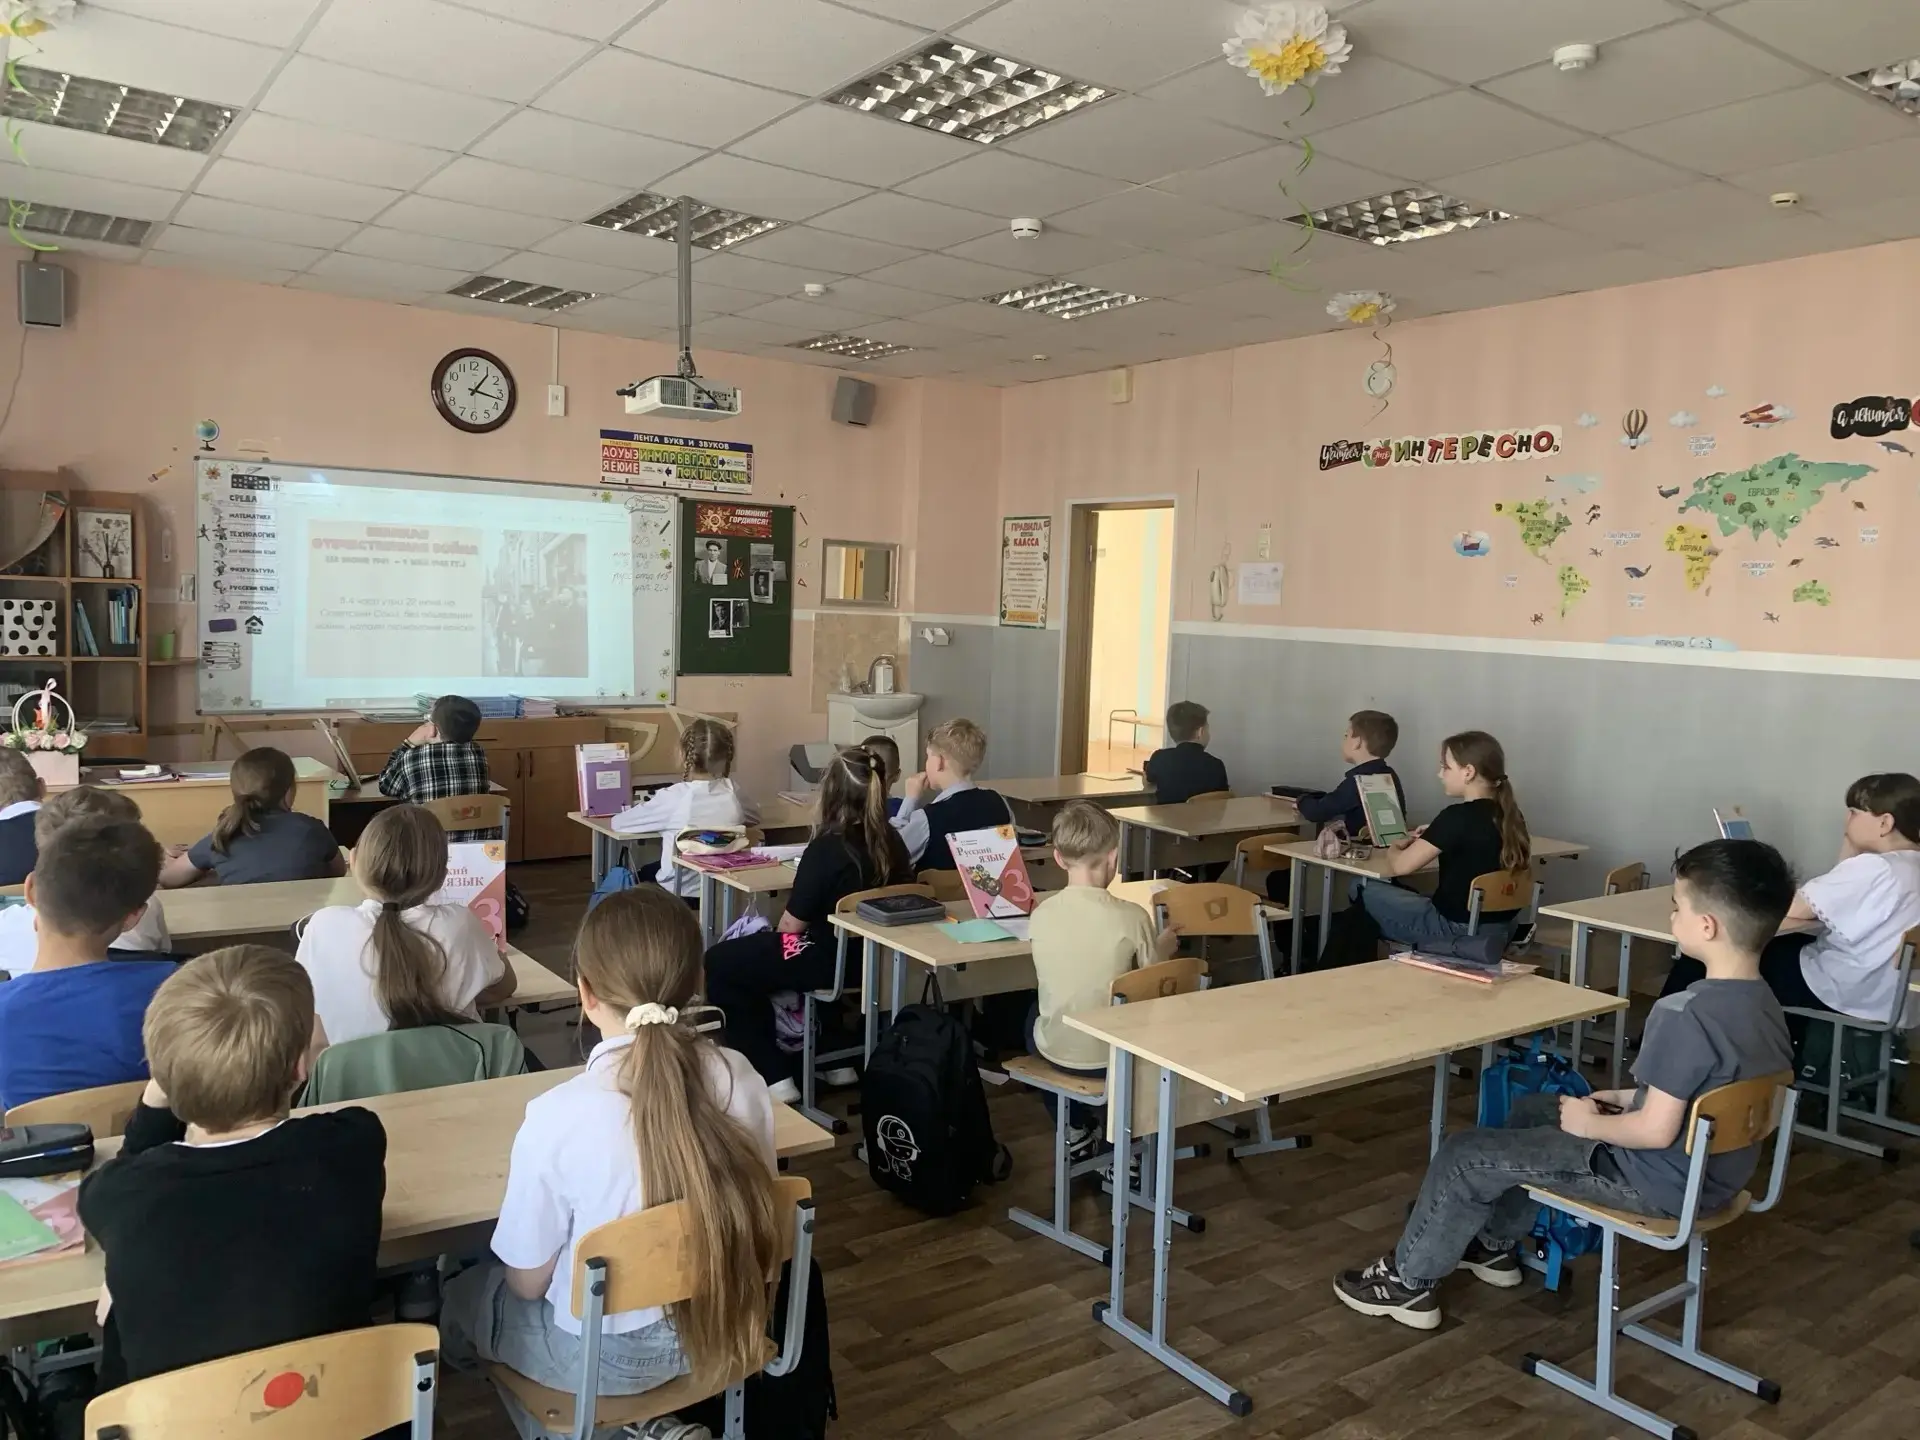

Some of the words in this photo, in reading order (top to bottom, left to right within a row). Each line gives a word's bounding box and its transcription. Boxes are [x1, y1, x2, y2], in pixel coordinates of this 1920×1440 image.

[459, 364, 466, 372] 11
[470, 361, 479, 371] 12
[450, 372, 459, 382] 10
[492, 376, 500, 386] 2
[444, 383, 452, 392] 9
[497, 389, 504, 398] 3
[448, 396, 456, 406] 8
[492, 402, 498, 410] 4
[460, 406, 466, 416] 7
[470, 411, 478, 421] 6
[484, 410, 490, 419] 5
[1837, 410, 1848, 427] а
[1850, 406, 1908, 428] лениться
[633, 433, 660, 444] ЛЕНТА
[664, 436, 684, 446] БУКВ
[688, 438, 695, 446] И
[698, 440, 730, 450] ЗВУКОВ
[1320, 445, 1361, 469] Учиться
[1748, 488, 1780, 497] ЕВРАЗИЯ
[229, 494, 258, 503] СРЕДА
[735, 508, 769, 518] ПОМНИМ!
[728, 516, 769, 526] ГОРДИМСЯ!
[1010, 522, 1043, 532] ПРАВИЛА
[230, 530, 276, 539] ТЕХНОЛОГИЯ
[1014, 538, 1039, 546] КЛАССА
[956, 846, 992, 858] Русский
[979, 852, 1006, 864] ЯЗЫК
[446, 876, 484, 887] ЯЗЫК
[1004, 868, 1031, 902] 3
[474, 898, 502, 941] 3
